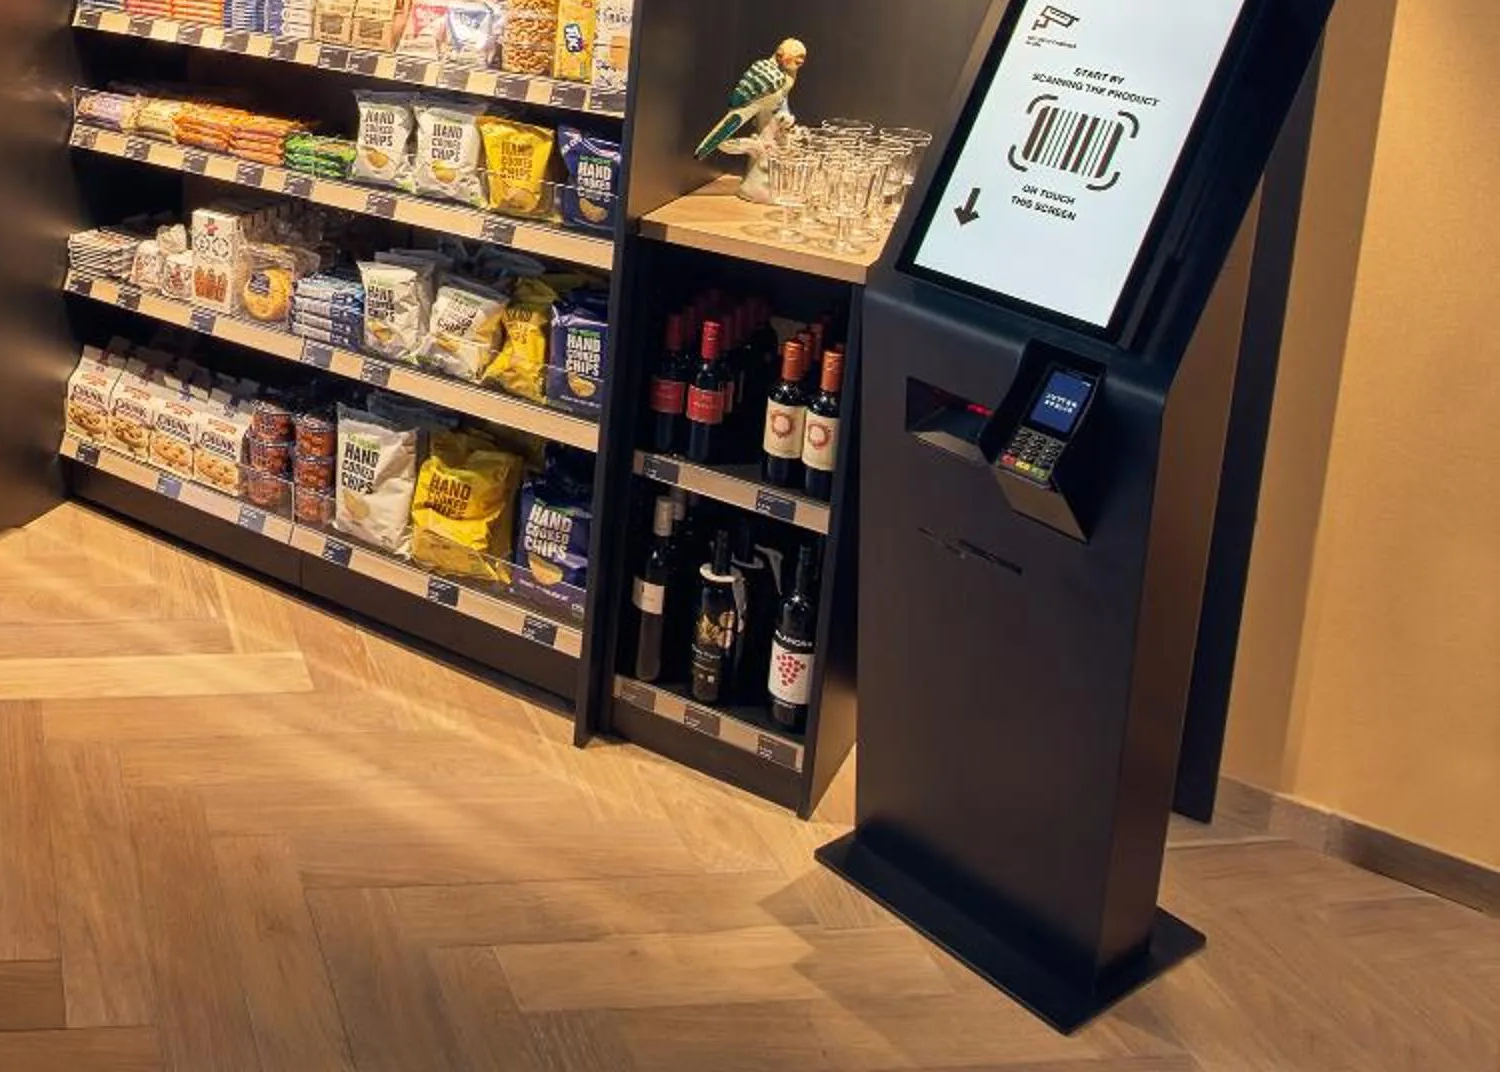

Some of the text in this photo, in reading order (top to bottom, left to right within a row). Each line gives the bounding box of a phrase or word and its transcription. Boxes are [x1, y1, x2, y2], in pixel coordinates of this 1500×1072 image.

[1074, 67, 1108, 81] START
[1032, 73, 1160, 107] SCANNING THE PRODUCT
[364, 133, 393, 147] CHIPS
[579, 161, 612, 180] HAND
[1011, 195, 1076, 221] THIS SCREEN
[1040, 189, 1076, 206] TOUCH
[567, 333, 601, 353] HAND
[564, 359, 600, 377] CHIPS
[345, 441, 380, 468] HAND
[342, 460, 375, 480] COOKED
[341, 472, 373, 495] CHIPS
[429, 472, 471, 501] HAND
[530, 503, 573, 533] HAND
[525, 521, 569, 545] COOKED
[524, 535, 567, 561] CHIPS
